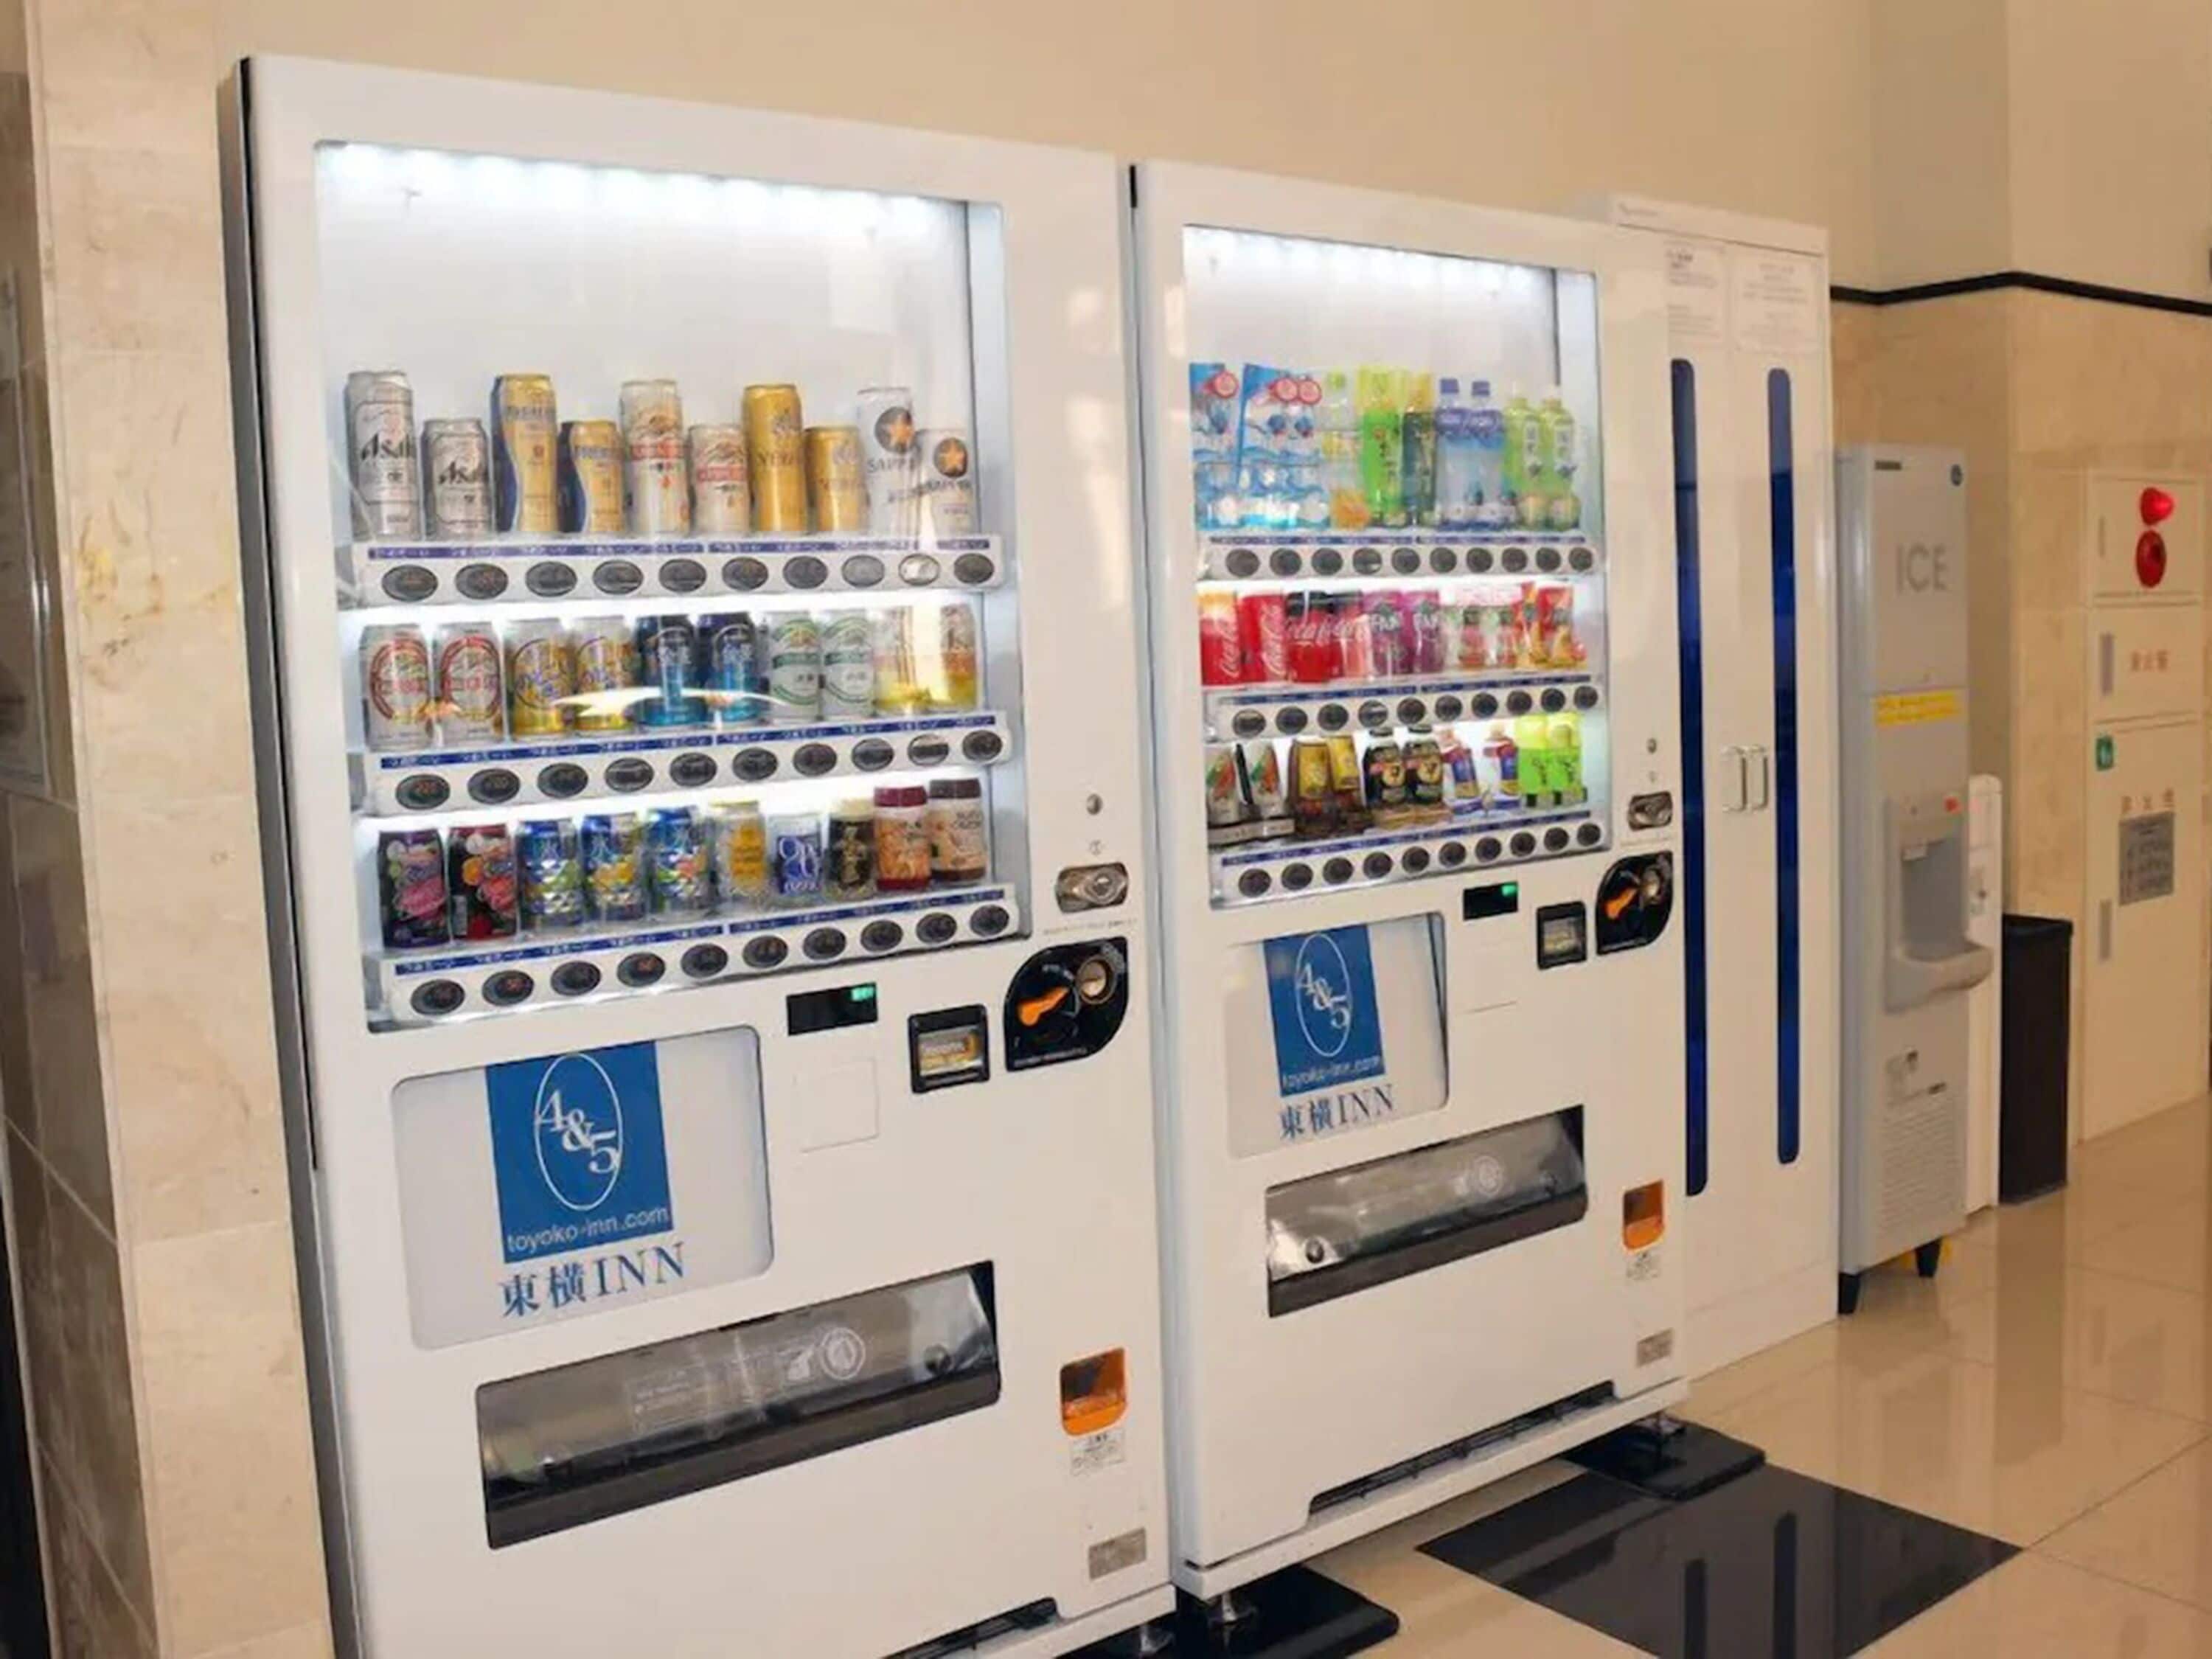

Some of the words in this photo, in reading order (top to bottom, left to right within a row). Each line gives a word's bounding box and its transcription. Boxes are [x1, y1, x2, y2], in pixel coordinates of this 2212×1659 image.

[1896, 543, 1949, 593] ICE
[1296, 961, 1351, 1030] 4&5
[537, 1088, 618, 1174] 4&5
[507, 1206, 669, 1255] toyoko-inn.com
[498, 1240, 686, 1317] 東横INN
